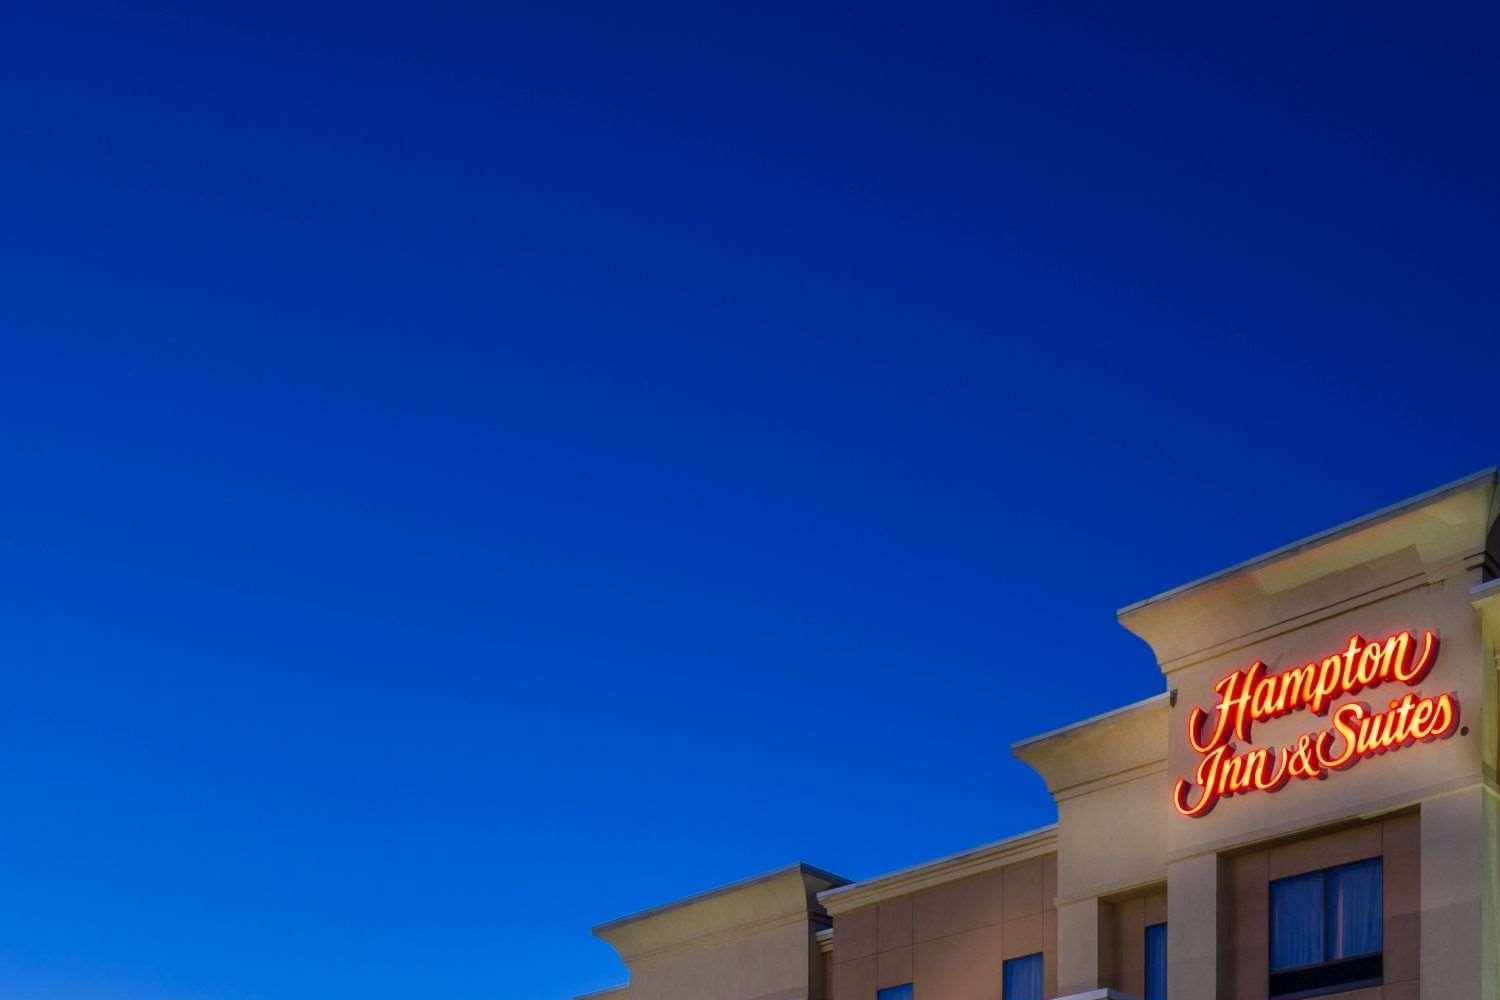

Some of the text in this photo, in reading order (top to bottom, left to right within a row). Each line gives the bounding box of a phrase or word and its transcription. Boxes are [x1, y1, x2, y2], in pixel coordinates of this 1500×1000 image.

[1174, 691, 1459, 816] Inn & Suites
[1188, 630, 1439, 753] Hampton
